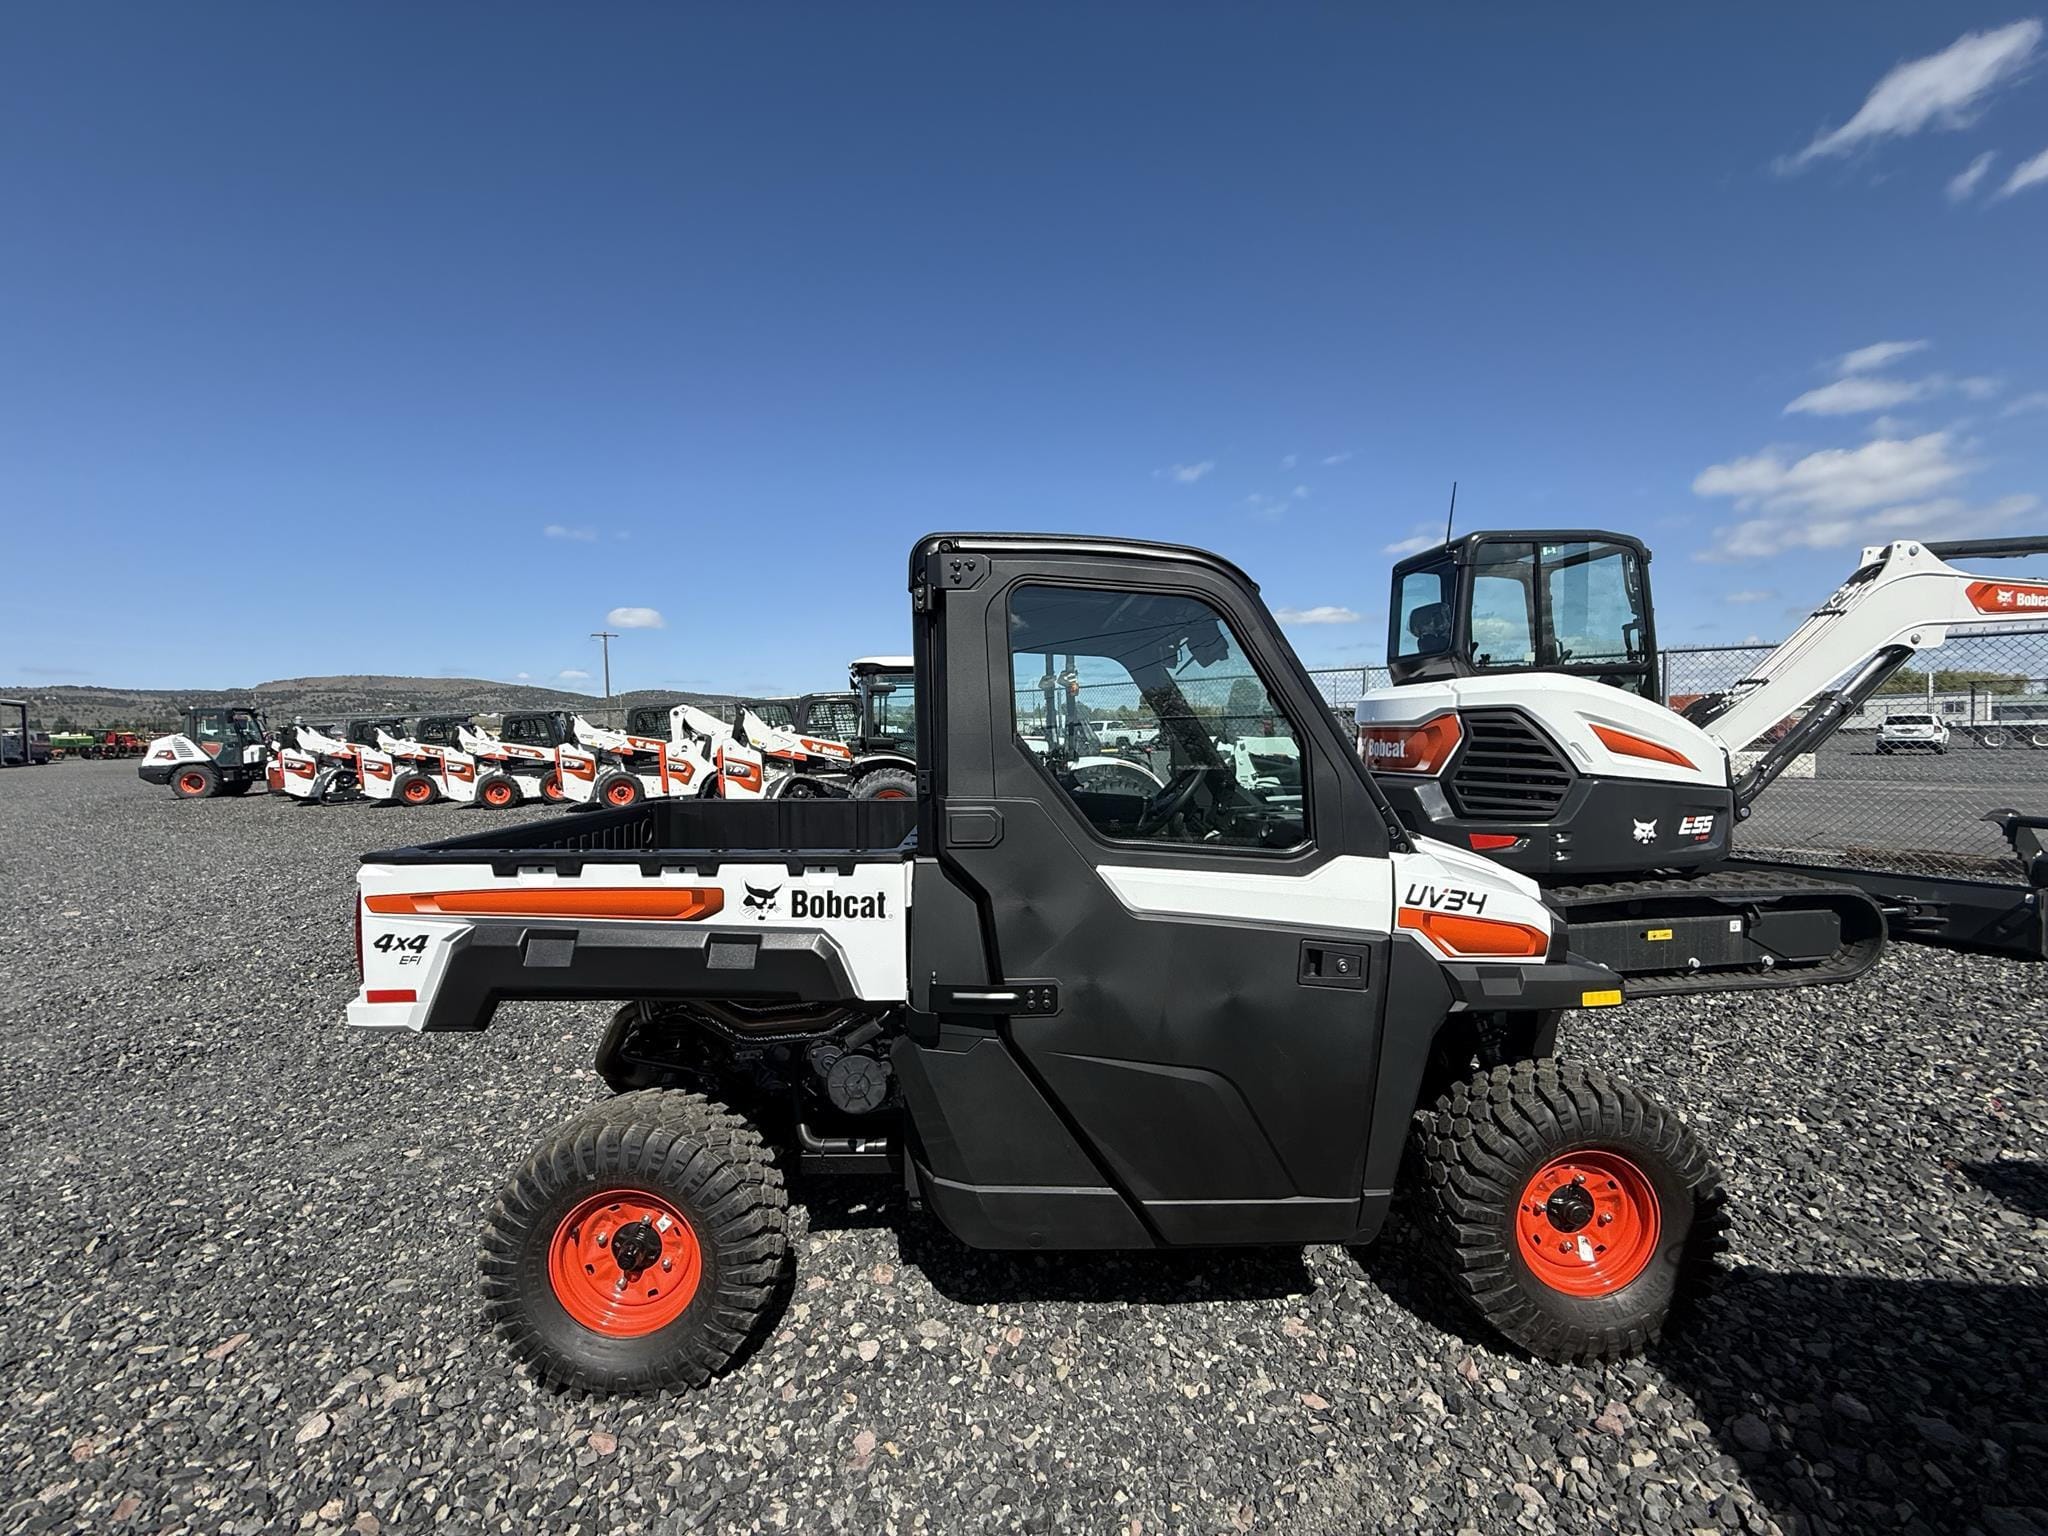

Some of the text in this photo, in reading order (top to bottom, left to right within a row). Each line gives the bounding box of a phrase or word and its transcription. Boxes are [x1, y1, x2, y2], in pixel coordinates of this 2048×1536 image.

[1369, 738, 1406, 758] Bobcat
[791, 890, 886, 918] Bobcat
[1405, 884, 1488, 914] UV34
[373, 934, 430, 953] 4x4
[399, 956, 422, 965] EFI
